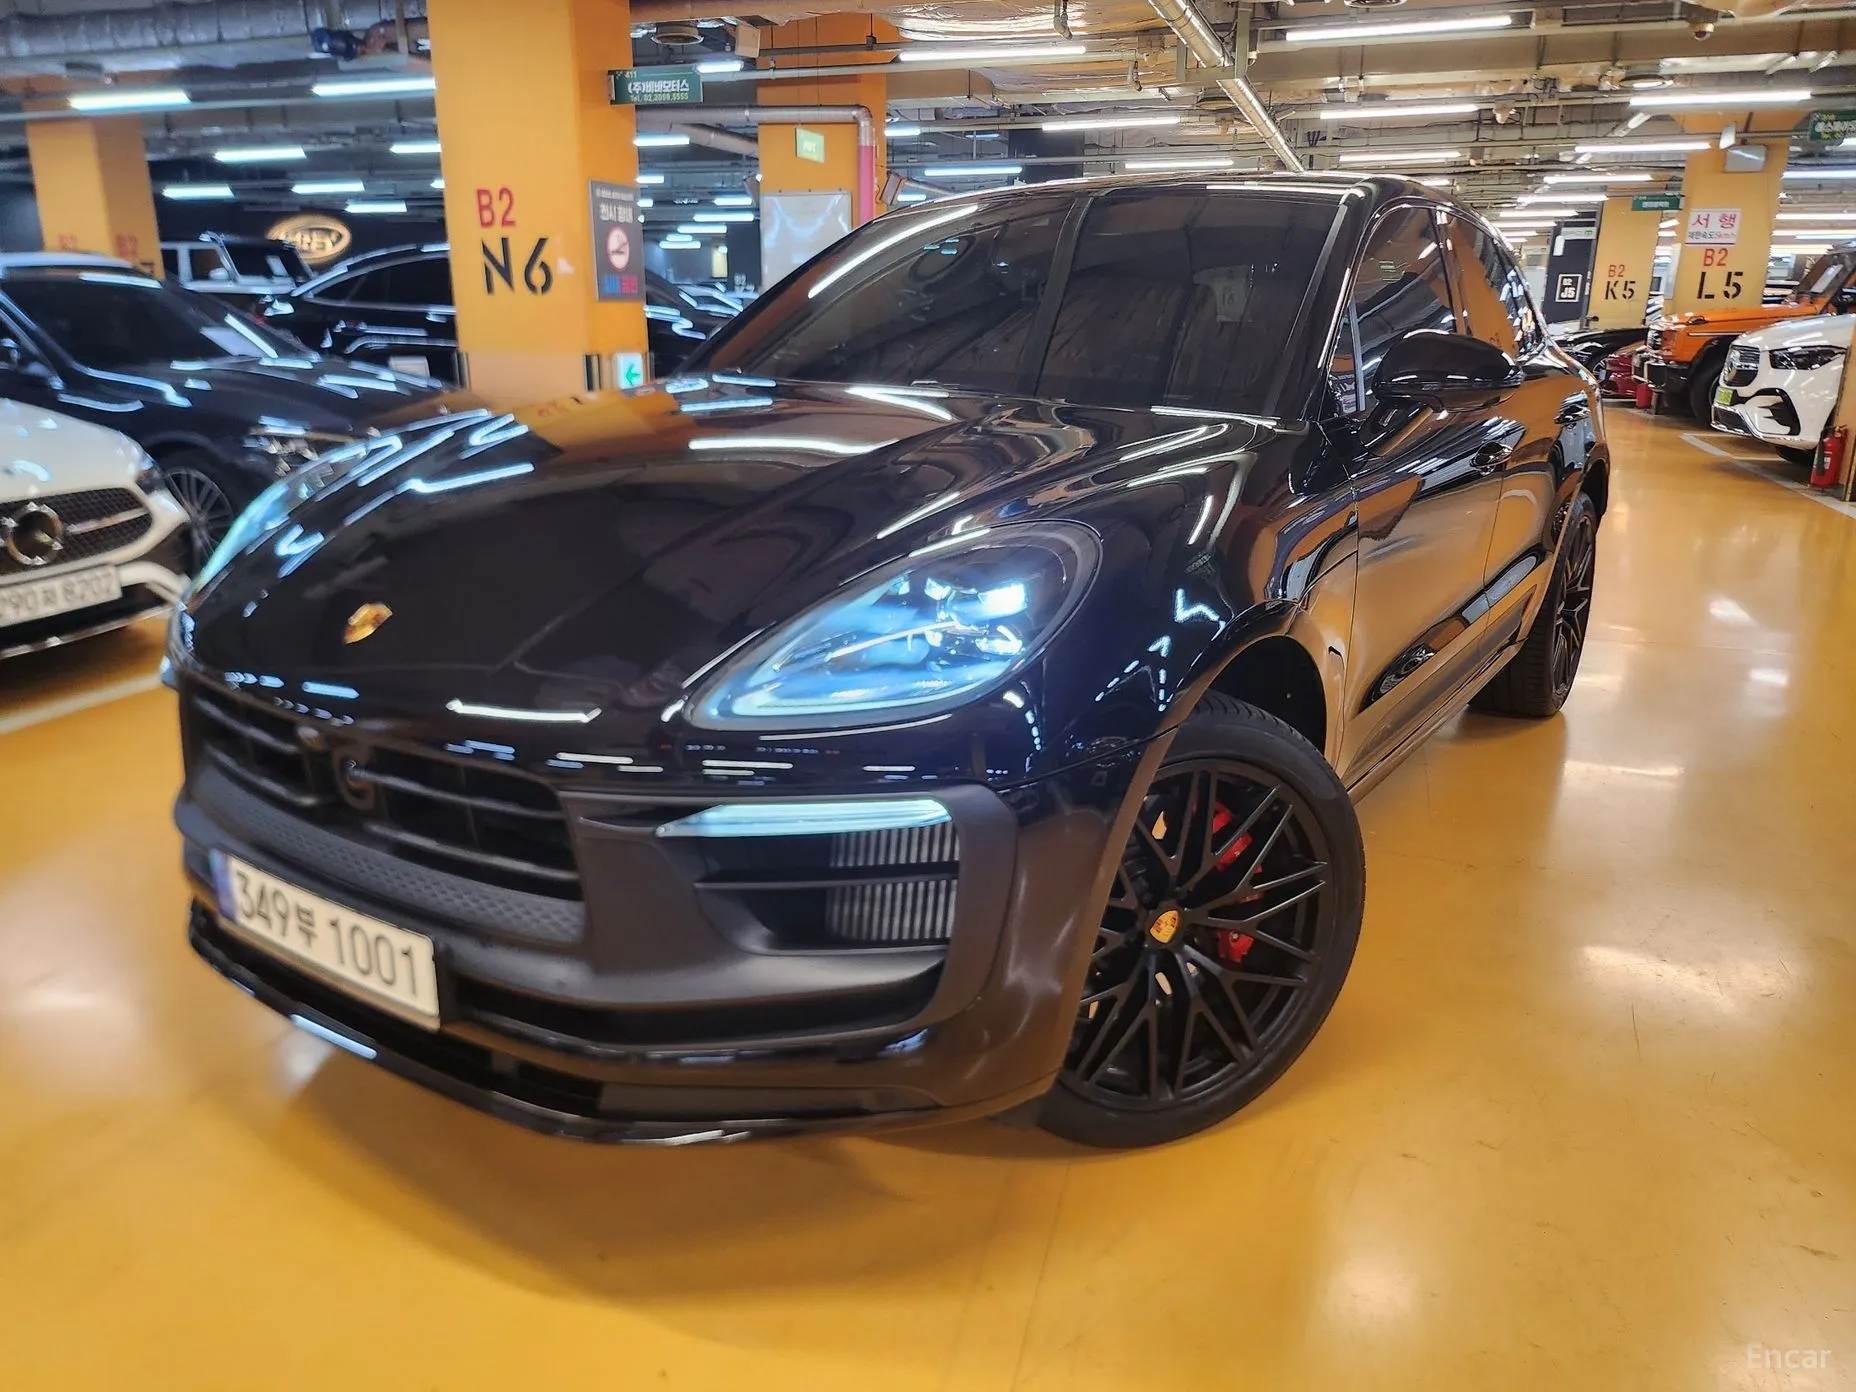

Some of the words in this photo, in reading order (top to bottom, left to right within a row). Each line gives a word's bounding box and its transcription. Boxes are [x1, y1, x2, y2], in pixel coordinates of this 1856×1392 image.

[476, 187, 516, 228] B2
[481, 237, 553, 296] N6
[1703, 248, 1728, 267] B2
[1608, 264, 1626, 278] B2
[1560, 287, 1576, 299] J5
[1604, 280, 1636, 300] K5
[1697, 271, 1744, 300] L5
[329, 914, 417, 998] 1001
